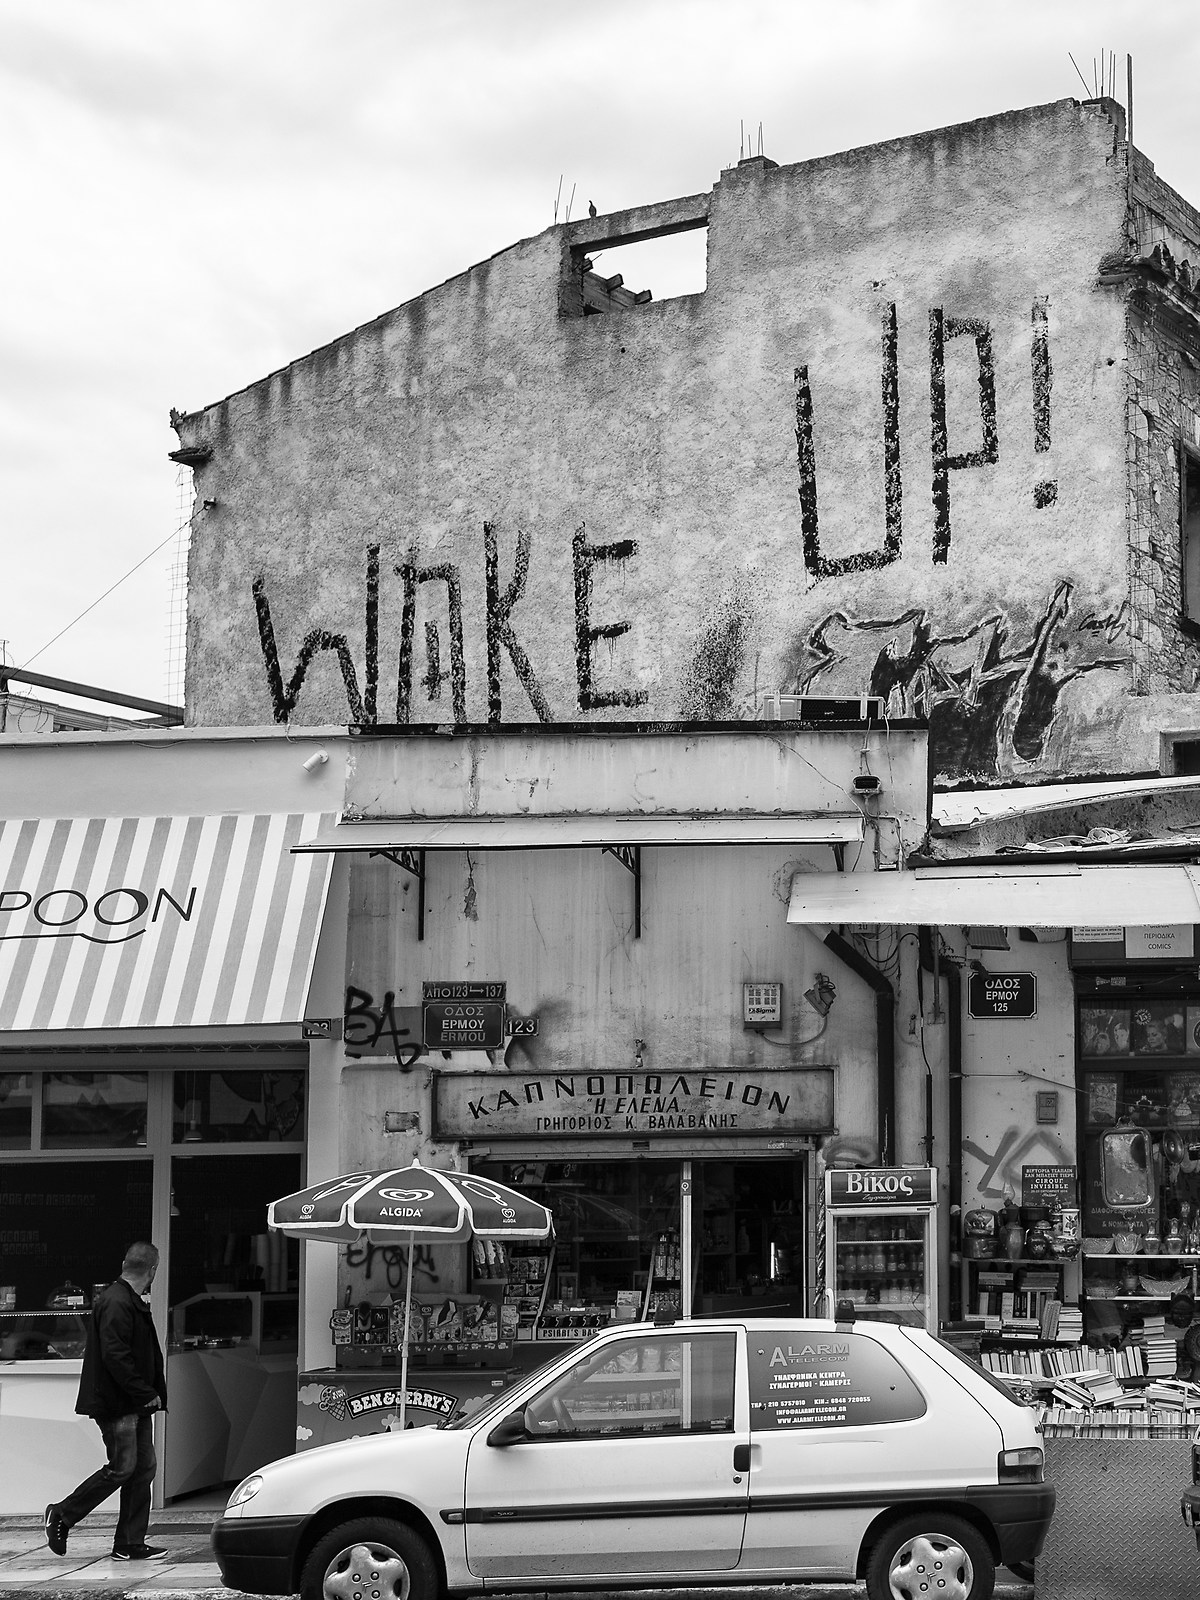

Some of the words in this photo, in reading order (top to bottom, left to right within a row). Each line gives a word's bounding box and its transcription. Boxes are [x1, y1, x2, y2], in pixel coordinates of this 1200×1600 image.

[252, 521, 650, 724] WAKE
[794, 296, 1060, 578] UP!
[985, 978, 1021, 989] ΟΔΟΣ
[426, 988, 451, 998] ΑΠΟ
[452, 985, 468, 998] 123
[485, 985, 503, 998] 137
[986, 991, 1019, 1001] ΕΡΜΟΥ
[444, 1006, 484, 1016] ΟΔΟΣ
[992, 1002, 1008, 1012] 125
[442, 1019, 485, 1030] ΕΡΜΟΥ
[508, 1019, 536, 1033] 123
[440, 1031, 486, 1042] ERMOU
[468, 1075, 790, 1119] ΚΑΠΝΟΠΩΛΕΙΟΝ
[536, 1115, 612, 1131] ΓΡΗΓΟΡΙΟΣ
[626, 1114, 637, 1129] Κ.
[648, 1113, 738, 1129] ΒΑΛΑΒΑΝΗΣ
[845, 1172, 914, 1196] Βίκος
[379, 1207, 422, 1218] ALGIDA
[769, 1343, 850, 1367] ALARM
[788, 1356, 848, 1364] TELECOM
[819, 1371, 846, 1379] ΚΕΝΤΡΑ
[769, 1381, 813, 1390] ΣΥΝΑΓΕΡΜΟΙ
[819, 1379, 852, 1387] ΚΑΜΕΡΕΣ
